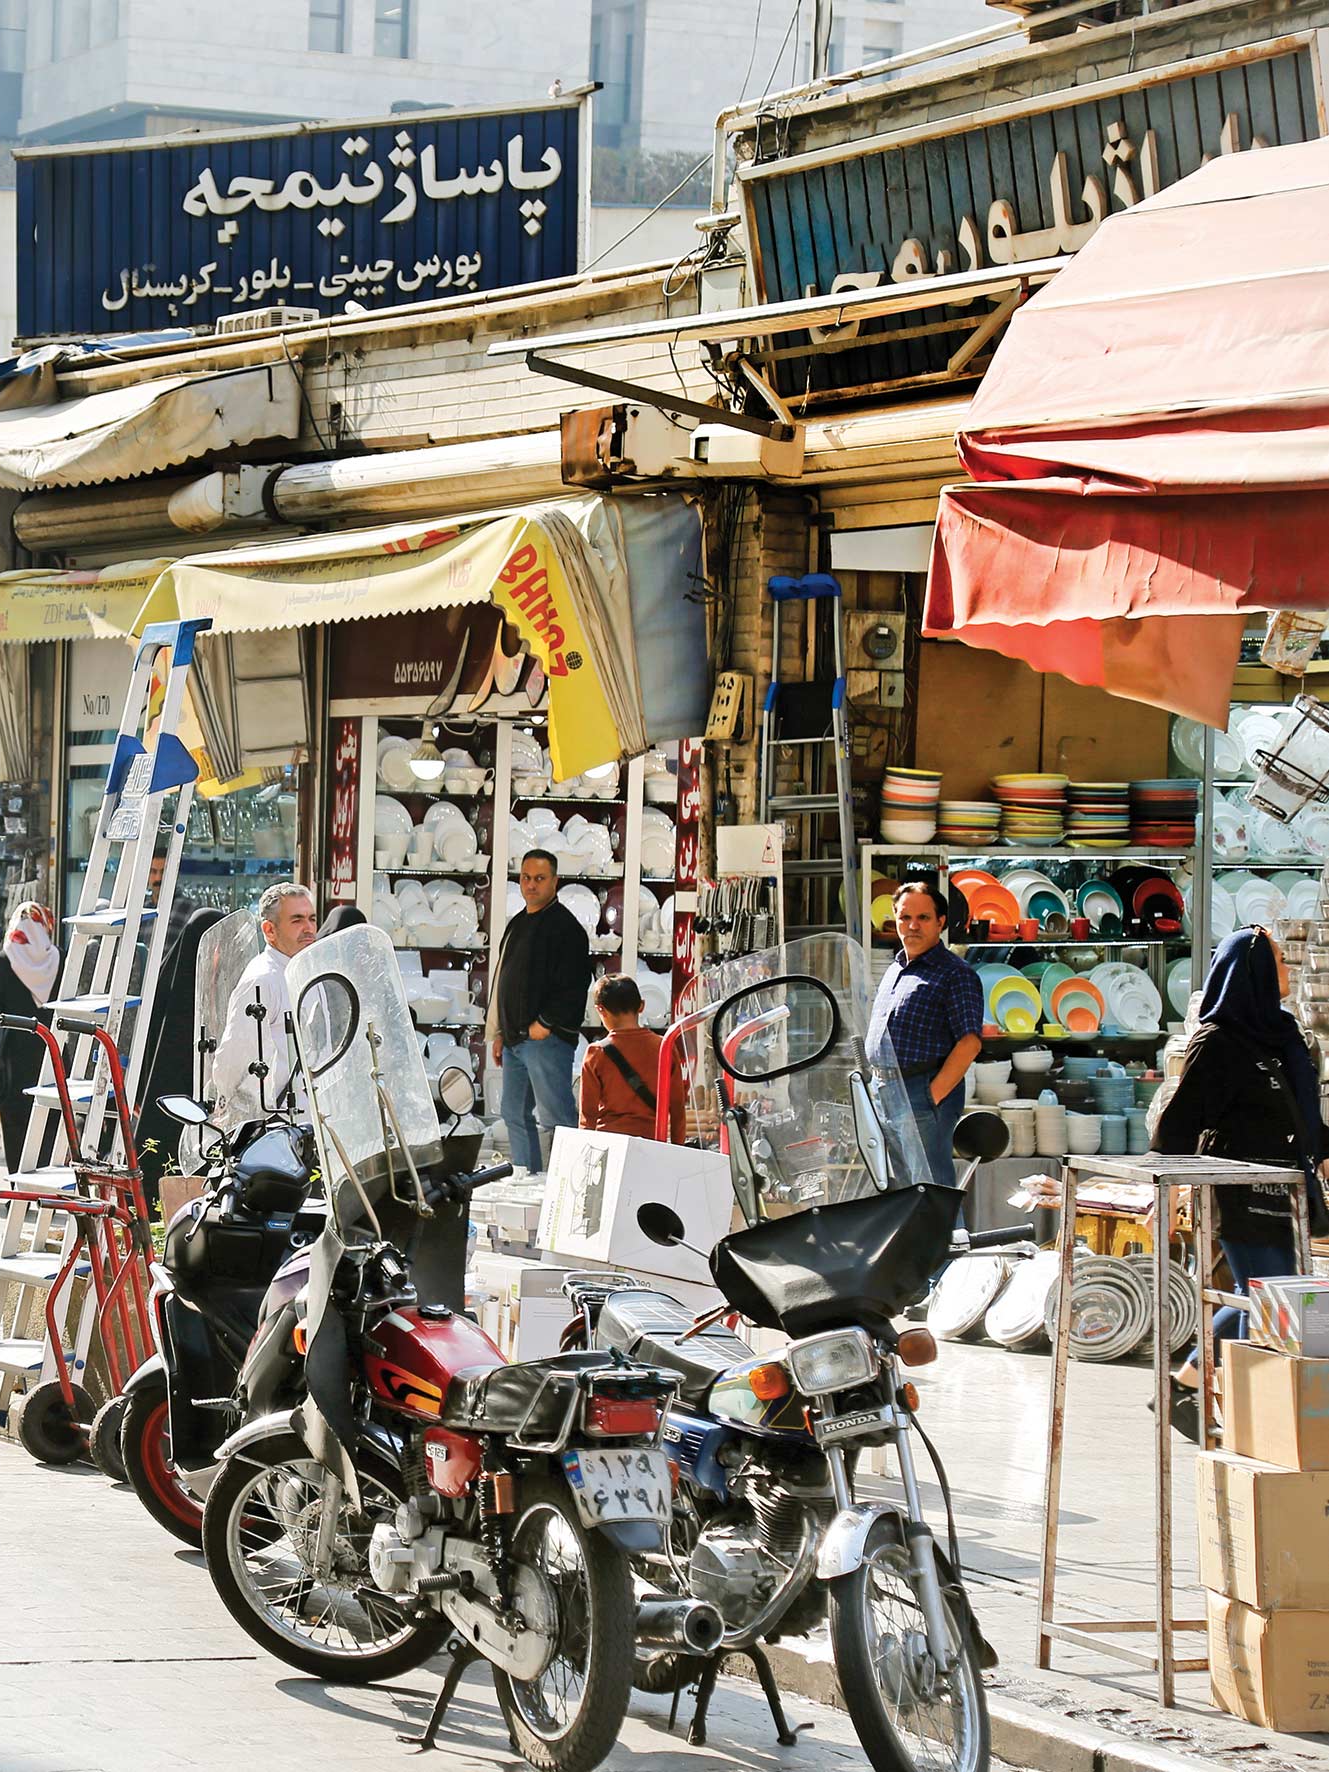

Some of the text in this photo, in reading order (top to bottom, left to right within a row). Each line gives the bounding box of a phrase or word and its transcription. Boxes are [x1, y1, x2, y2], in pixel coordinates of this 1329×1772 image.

[183, 130, 562, 243] پاساژ تیمچه
[102, 251, 482, 316] بورس چینی بلور کریستال
[83, 694, 111, 716] No/170
[336, 723, 357, 773] پخش
[824, 1414, 879, 1433] HONDA
